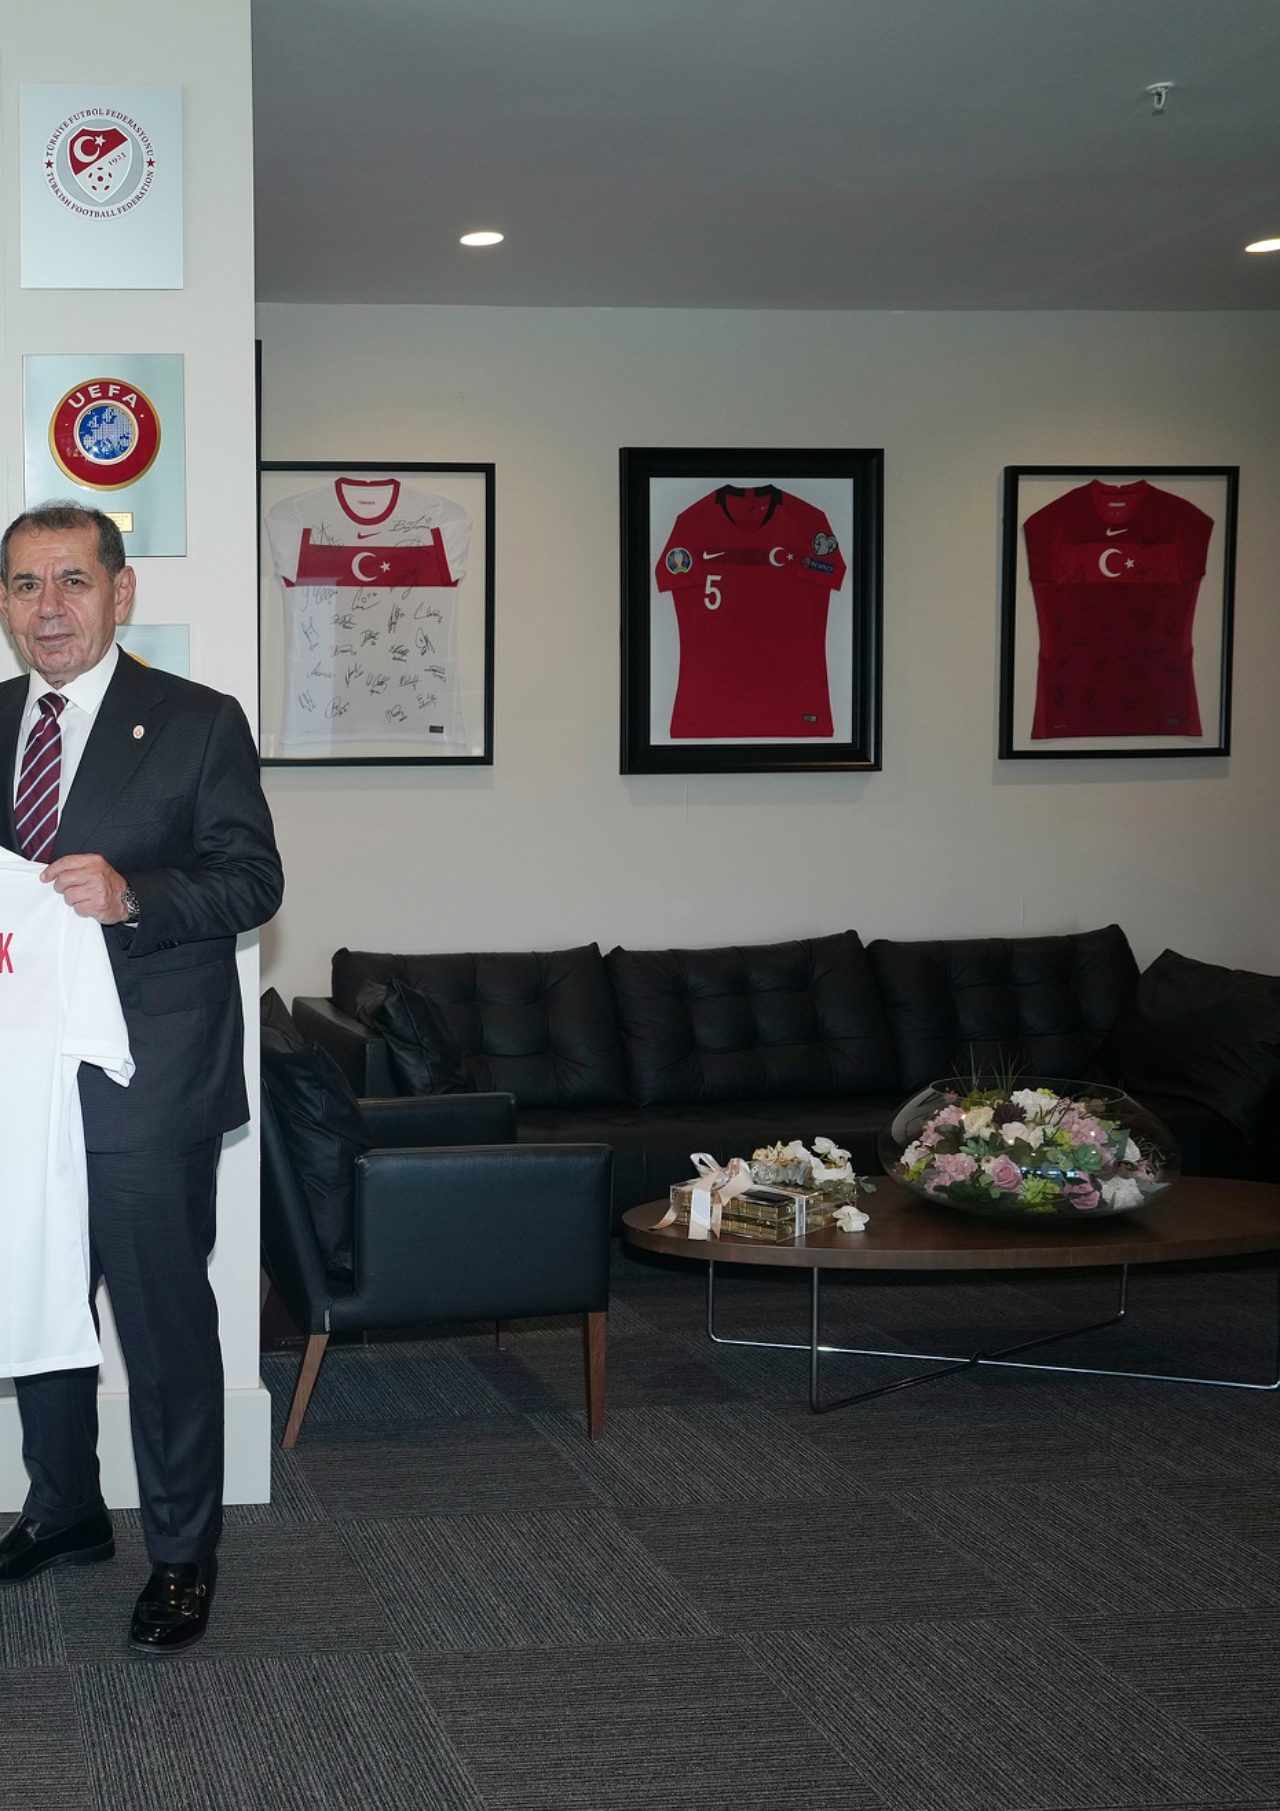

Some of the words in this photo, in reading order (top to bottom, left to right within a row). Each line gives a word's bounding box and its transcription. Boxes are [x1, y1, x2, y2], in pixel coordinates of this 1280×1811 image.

[46, 120, 70, 156] TÜRKİYE
[68, 108, 105, 124] FUTBOL
[105, 109, 154, 156] FEDERASYONU
[47, 172, 72, 209] TURKISH
[70, 204, 117, 218] FOOTBALL
[116, 170, 154, 214] FEDERATION
[68, 384, 137, 408] UEFA
[704, 575, 722, 610] 5
